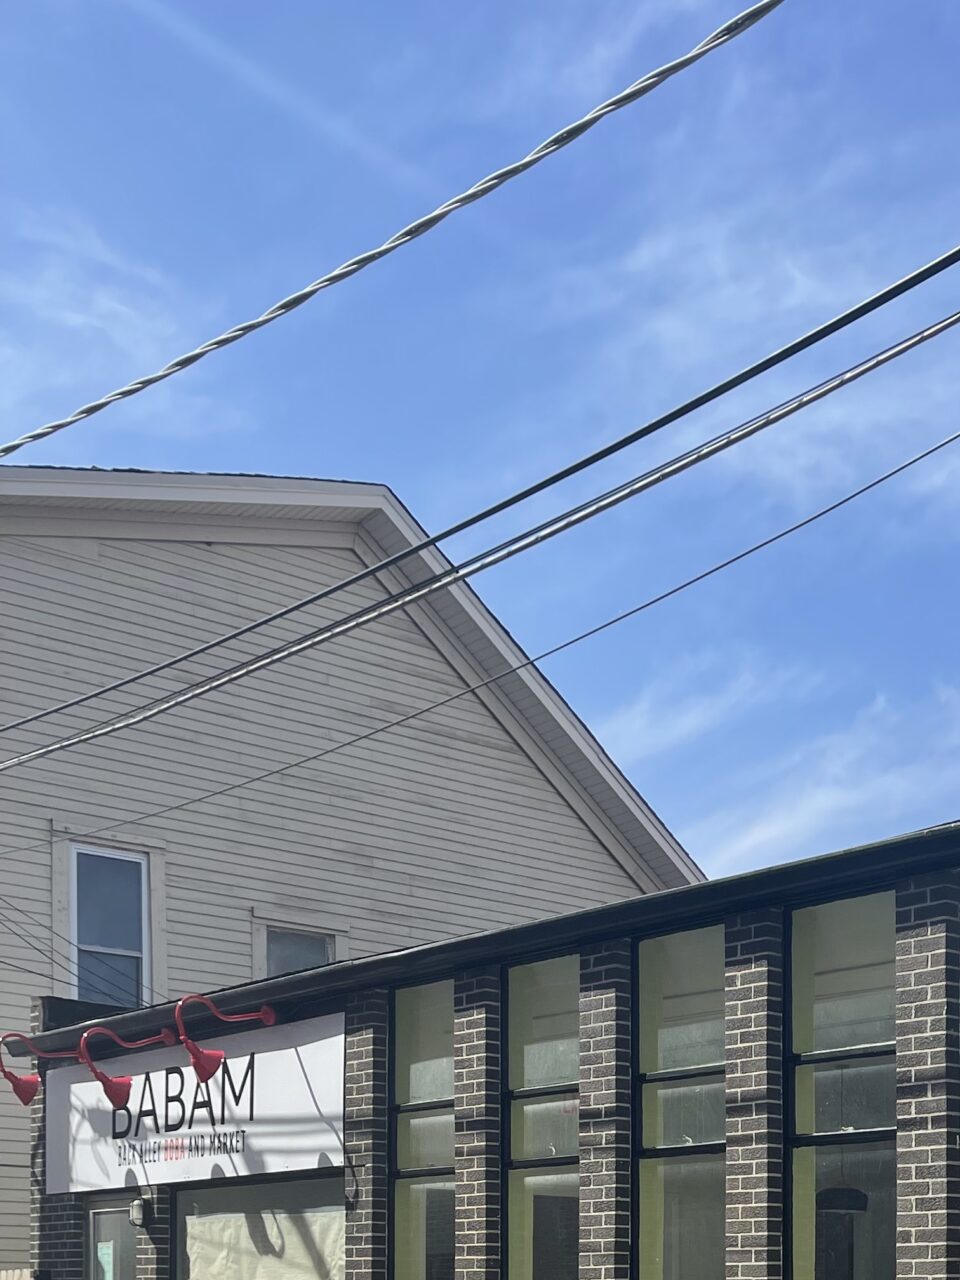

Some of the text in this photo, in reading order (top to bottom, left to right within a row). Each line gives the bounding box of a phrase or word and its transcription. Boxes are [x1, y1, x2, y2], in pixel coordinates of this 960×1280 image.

[164, 1137, 185, 1161] BOBA
[188, 1134, 205, 1159] AND
[209, 1130, 246, 1156] MARKET
